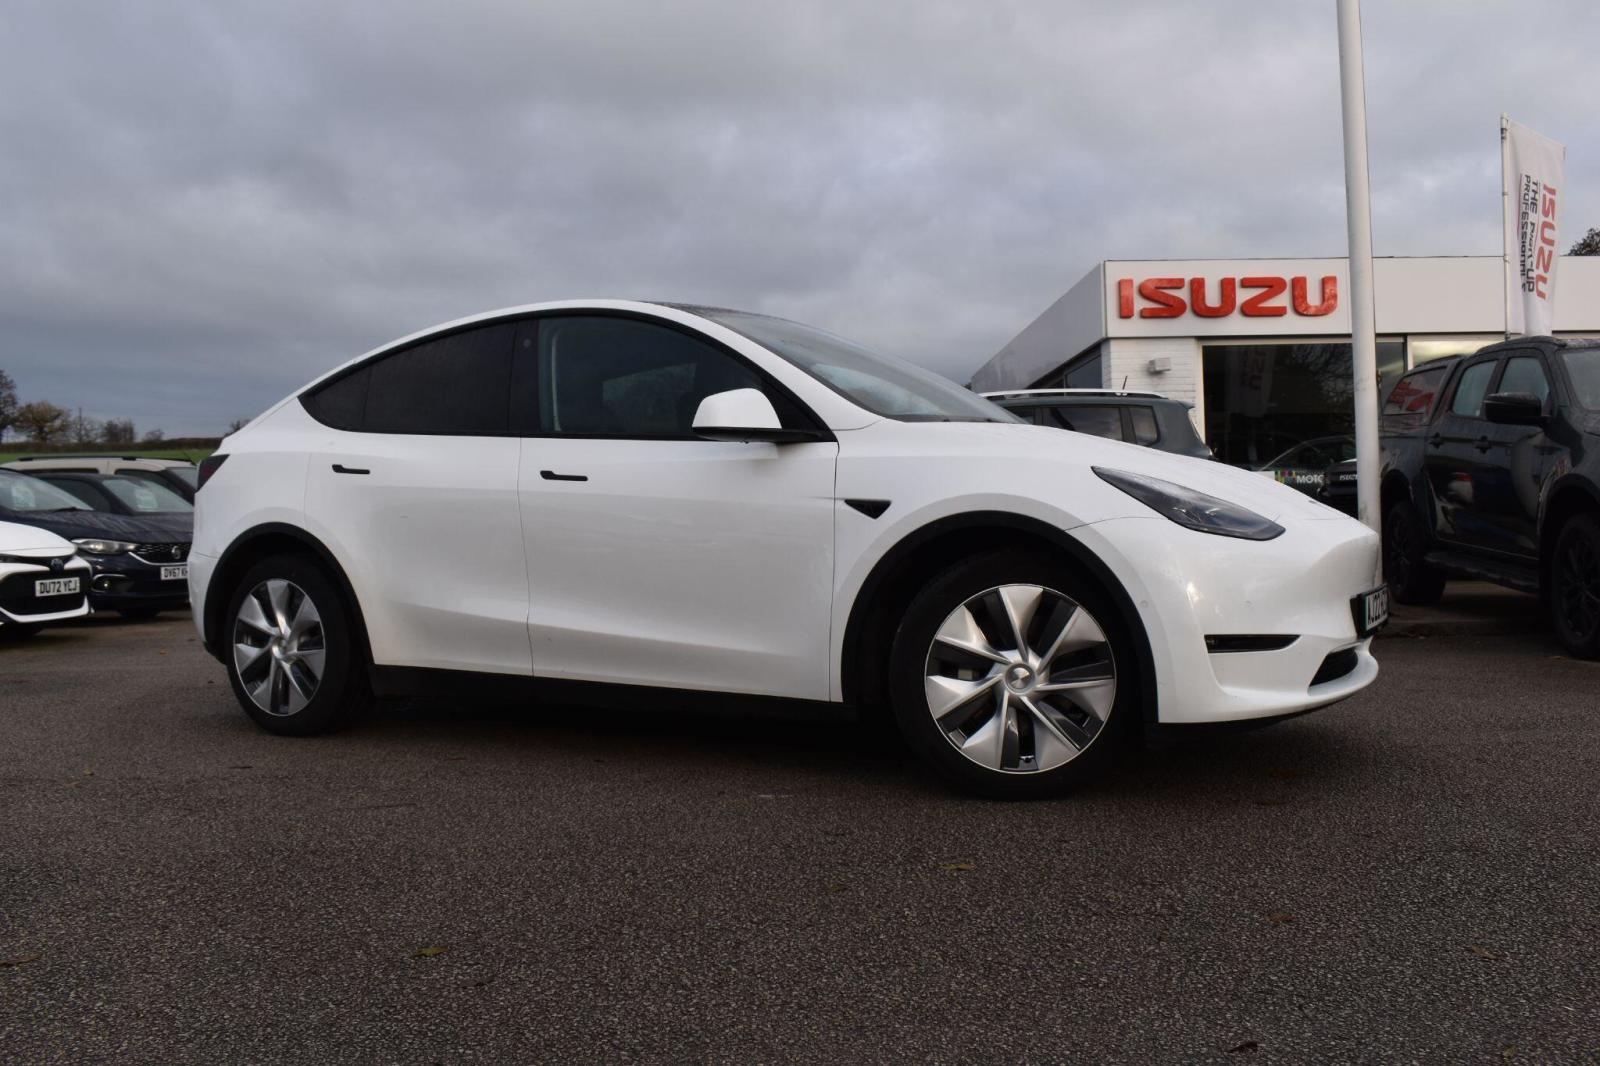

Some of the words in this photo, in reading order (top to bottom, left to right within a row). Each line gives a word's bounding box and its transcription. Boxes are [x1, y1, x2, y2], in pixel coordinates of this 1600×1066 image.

[1530, 181, 1538, 215] THE
[1535, 183, 1556, 300] ISUZU
[1118, 276, 1338, 319] ISUZU
[39, 581, 62, 594] DU72
